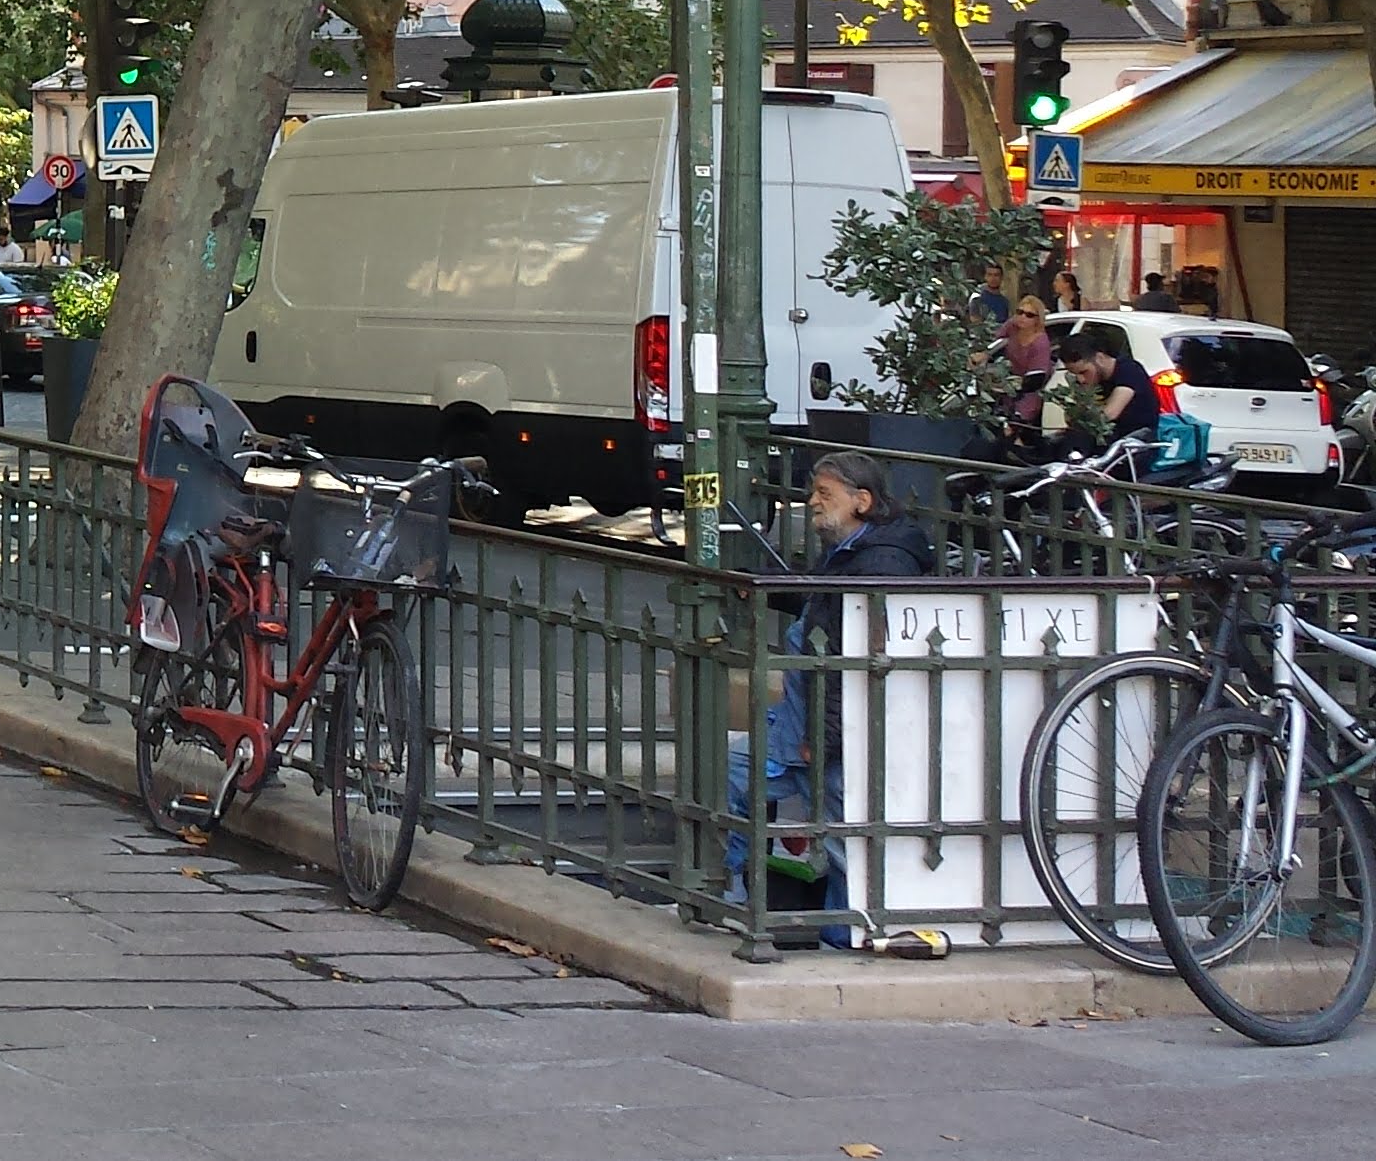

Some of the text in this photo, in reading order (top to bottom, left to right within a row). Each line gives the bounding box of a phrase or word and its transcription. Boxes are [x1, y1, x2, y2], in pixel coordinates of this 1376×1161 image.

[52, 164, 69, 179] 30
[1196, 172, 1360, 191] DROIT ECONOMIE
